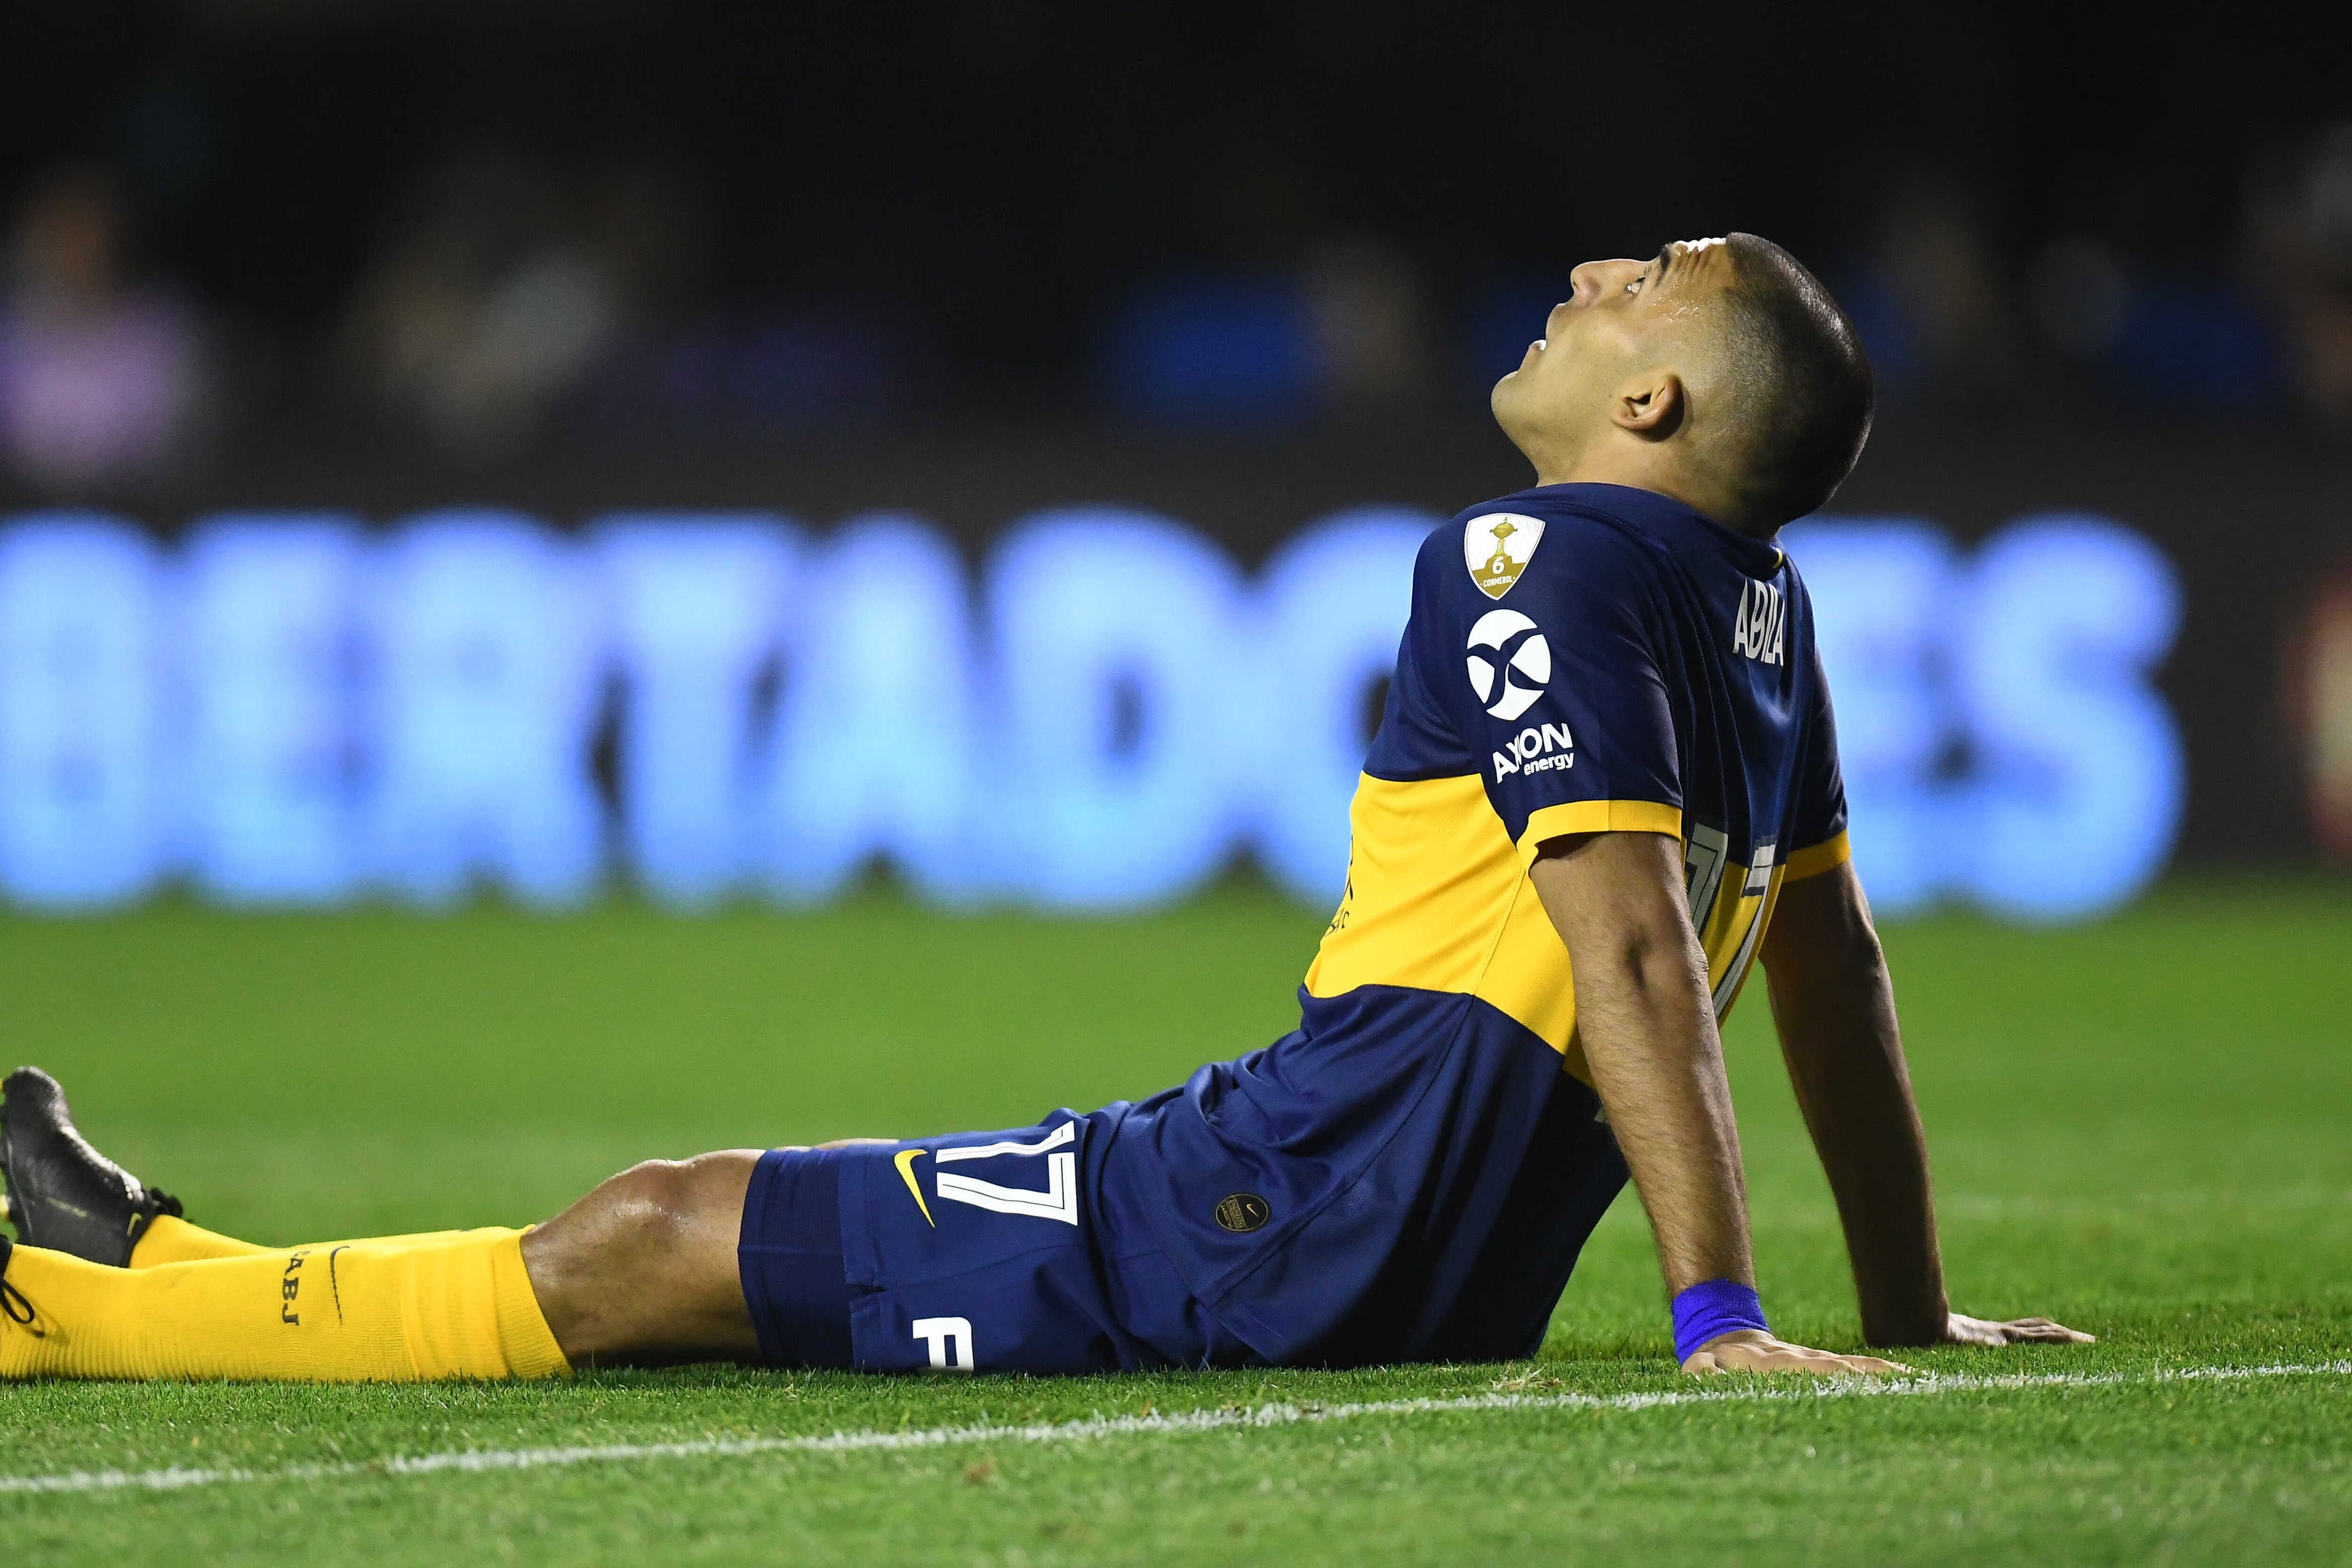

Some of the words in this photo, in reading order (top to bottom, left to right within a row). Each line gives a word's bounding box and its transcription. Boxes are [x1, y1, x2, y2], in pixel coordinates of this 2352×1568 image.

[1483, 575, 1513, 588] CONMEBOL
[1492, 556, 1505, 574] 6
[1732, 577, 1785, 667] ABILA
[0, 510, 2187, 917] BERTADES
[1524, 752, 1574, 776] energy
[935, 1120, 1078, 1226] 17
